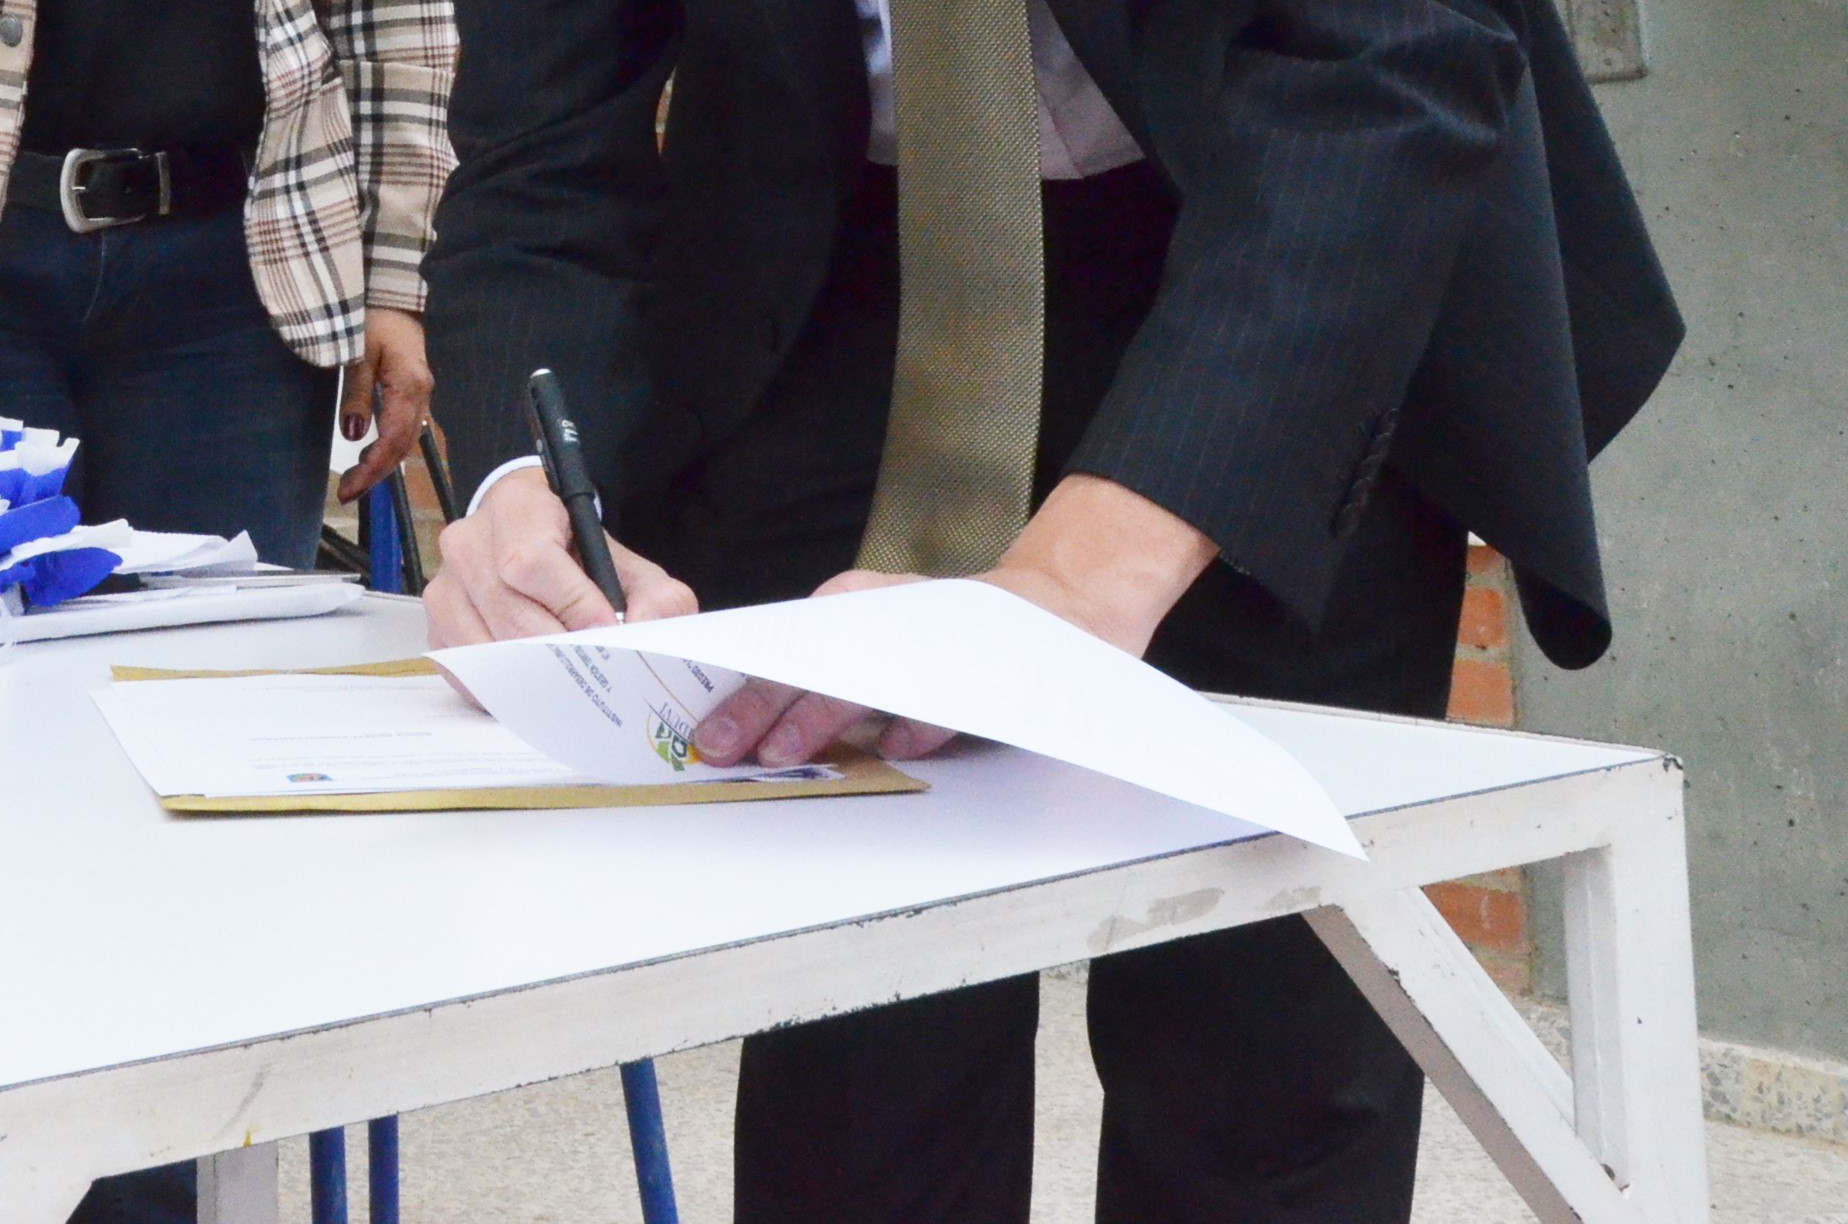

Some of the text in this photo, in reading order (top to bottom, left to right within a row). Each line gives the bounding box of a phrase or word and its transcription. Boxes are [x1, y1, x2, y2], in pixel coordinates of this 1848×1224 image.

[583, 685, 594, 698] DE
[691, 665, 714, 692] PREDIO
[592, 694, 623, 728] INSTITUTO
